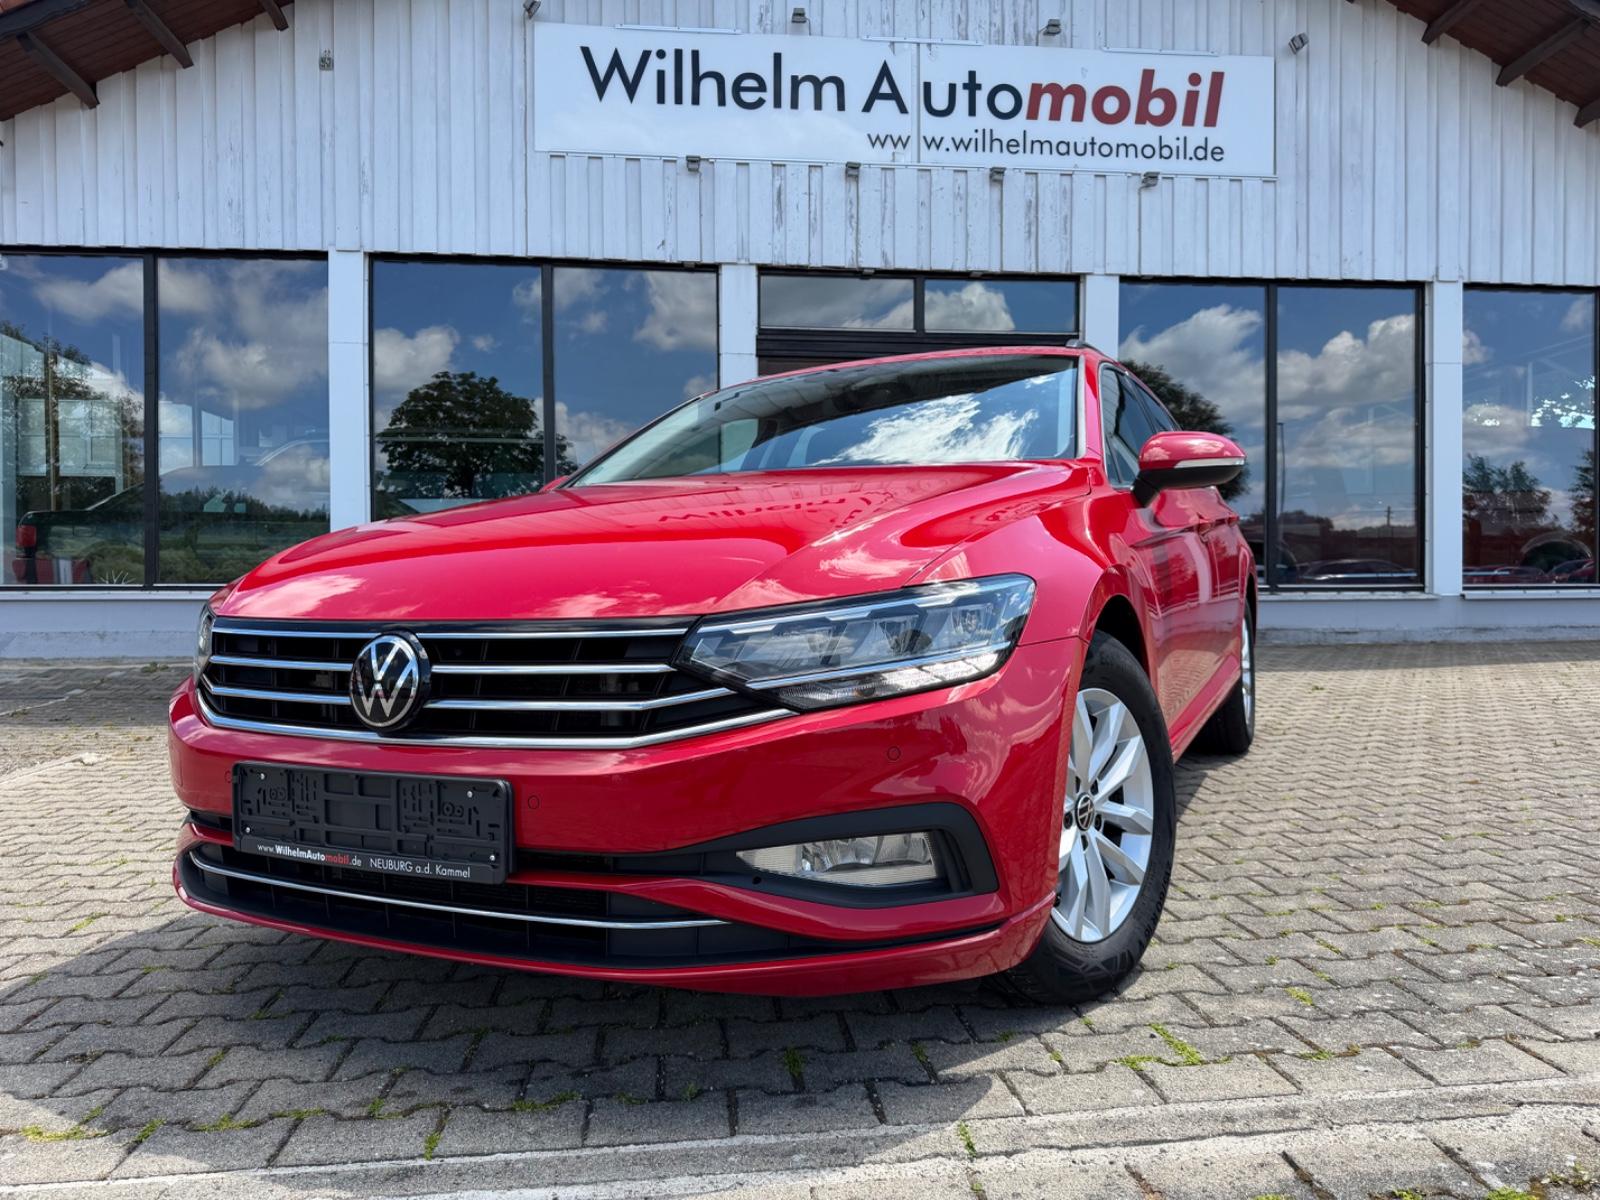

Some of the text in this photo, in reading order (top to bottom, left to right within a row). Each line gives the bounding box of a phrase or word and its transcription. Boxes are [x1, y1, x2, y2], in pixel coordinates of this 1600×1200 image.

[579, 45, 1226, 128] Wilhelm Automobil
[866, 128, 1225, 163] www.wilhelmautomobil.de
[369, 858, 413, 873] NEUBURG
[415, 862, 433, 875] a.d.
[435, 864, 471, 878] Kammel
